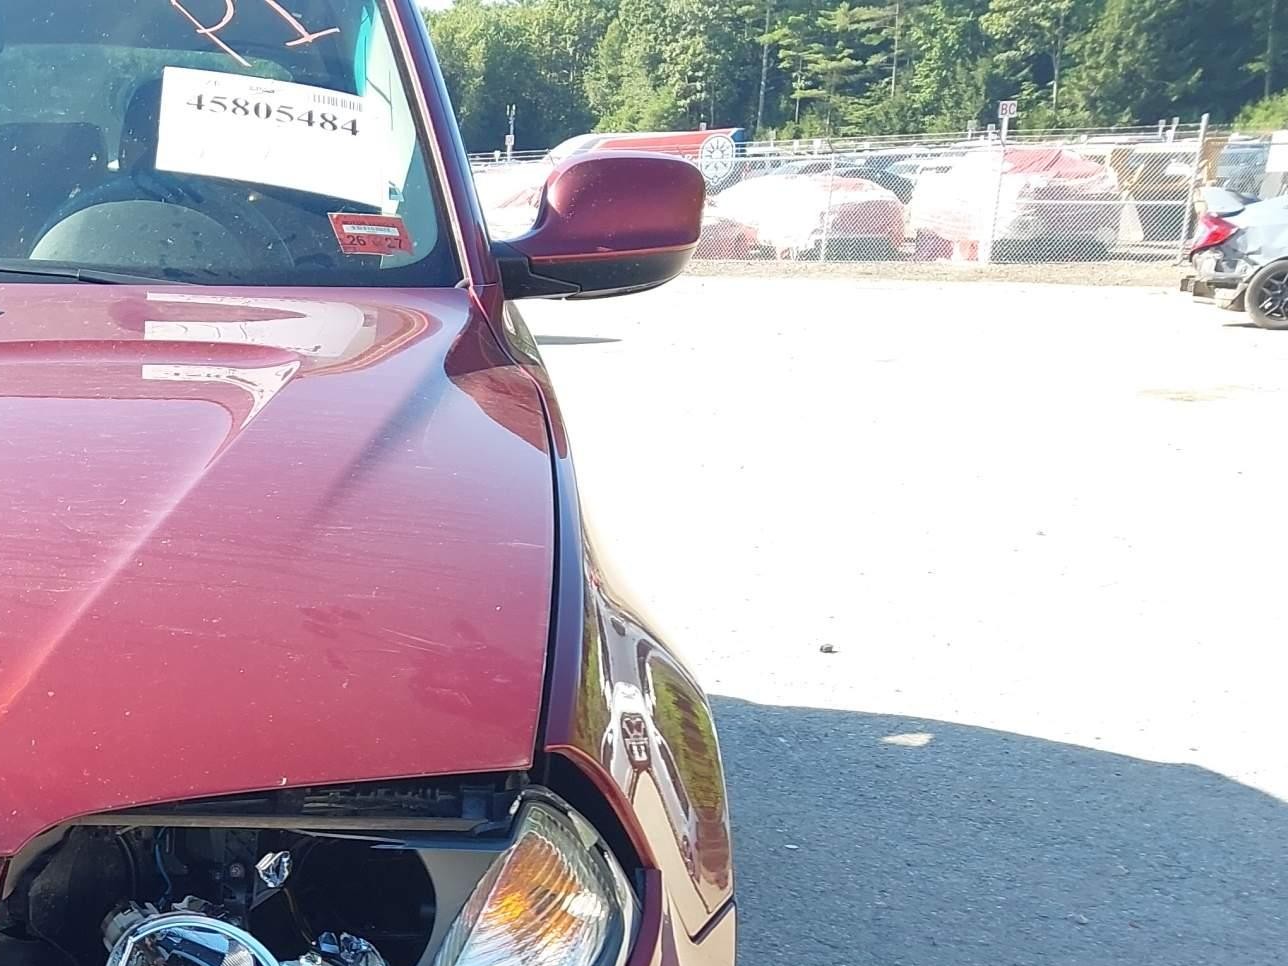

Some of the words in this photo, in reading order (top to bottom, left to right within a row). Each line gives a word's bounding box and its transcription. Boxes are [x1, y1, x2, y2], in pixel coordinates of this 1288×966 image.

[186, 93, 360, 136] 45805484
[1001, 103, 1016, 115] BC
[346, 235, 366, 246] 26
[385, 237, 402, 249] 27
